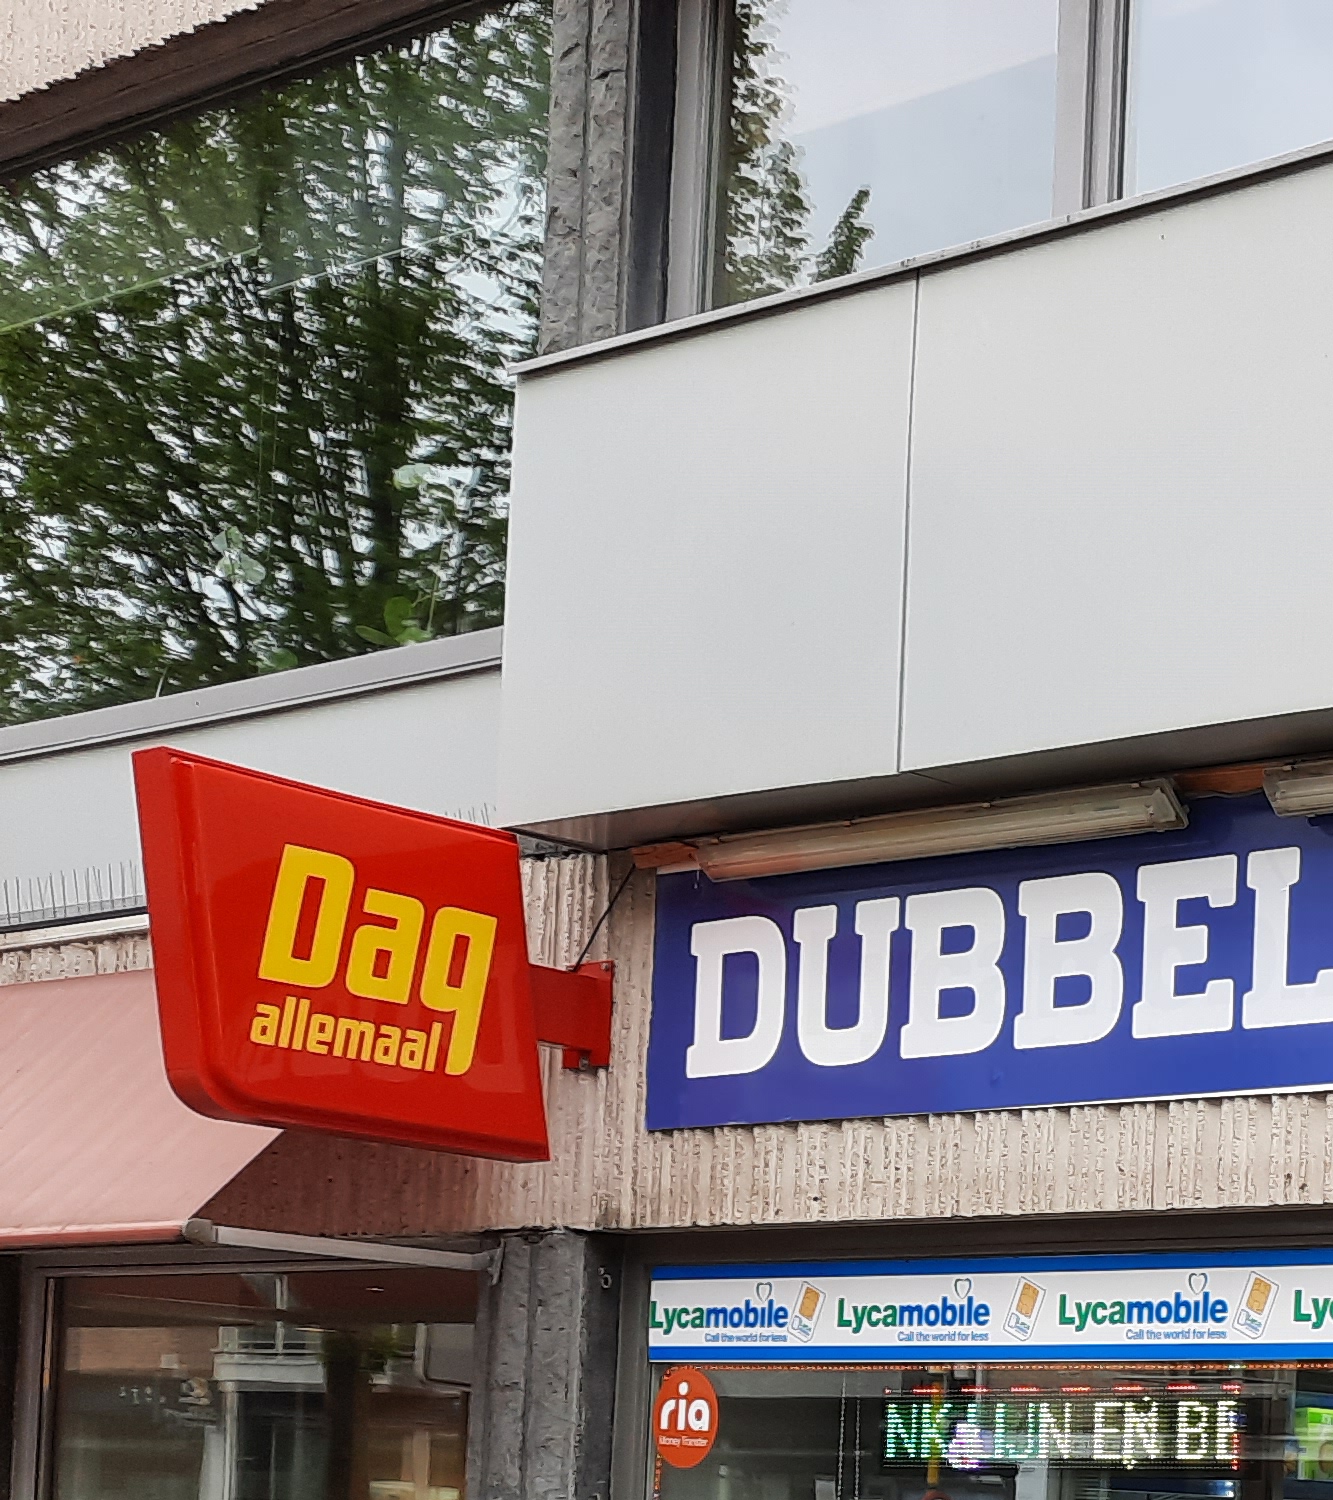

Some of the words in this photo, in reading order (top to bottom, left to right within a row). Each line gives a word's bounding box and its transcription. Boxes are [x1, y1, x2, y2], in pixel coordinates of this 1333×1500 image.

[258, 843, 498, 1076] Dag
[250, 996, 442, 1072] allemaal
[650, 1299, 789, 1335] Lycamobile
[837, 1296, 990, 1334] Lycamobile
[1058, 1292, 1228, 1332] Lycamobile
[1126, 1329, 1144, 1340] Call
[1146, 1329, 1162, 1340] the
[1163, 1329, 1190, 1340] world
[1193, 1329, 1206, 1340] for
[1207, 1328, 1226, 1340] less
[660, 1381, 710, 1431] ria
